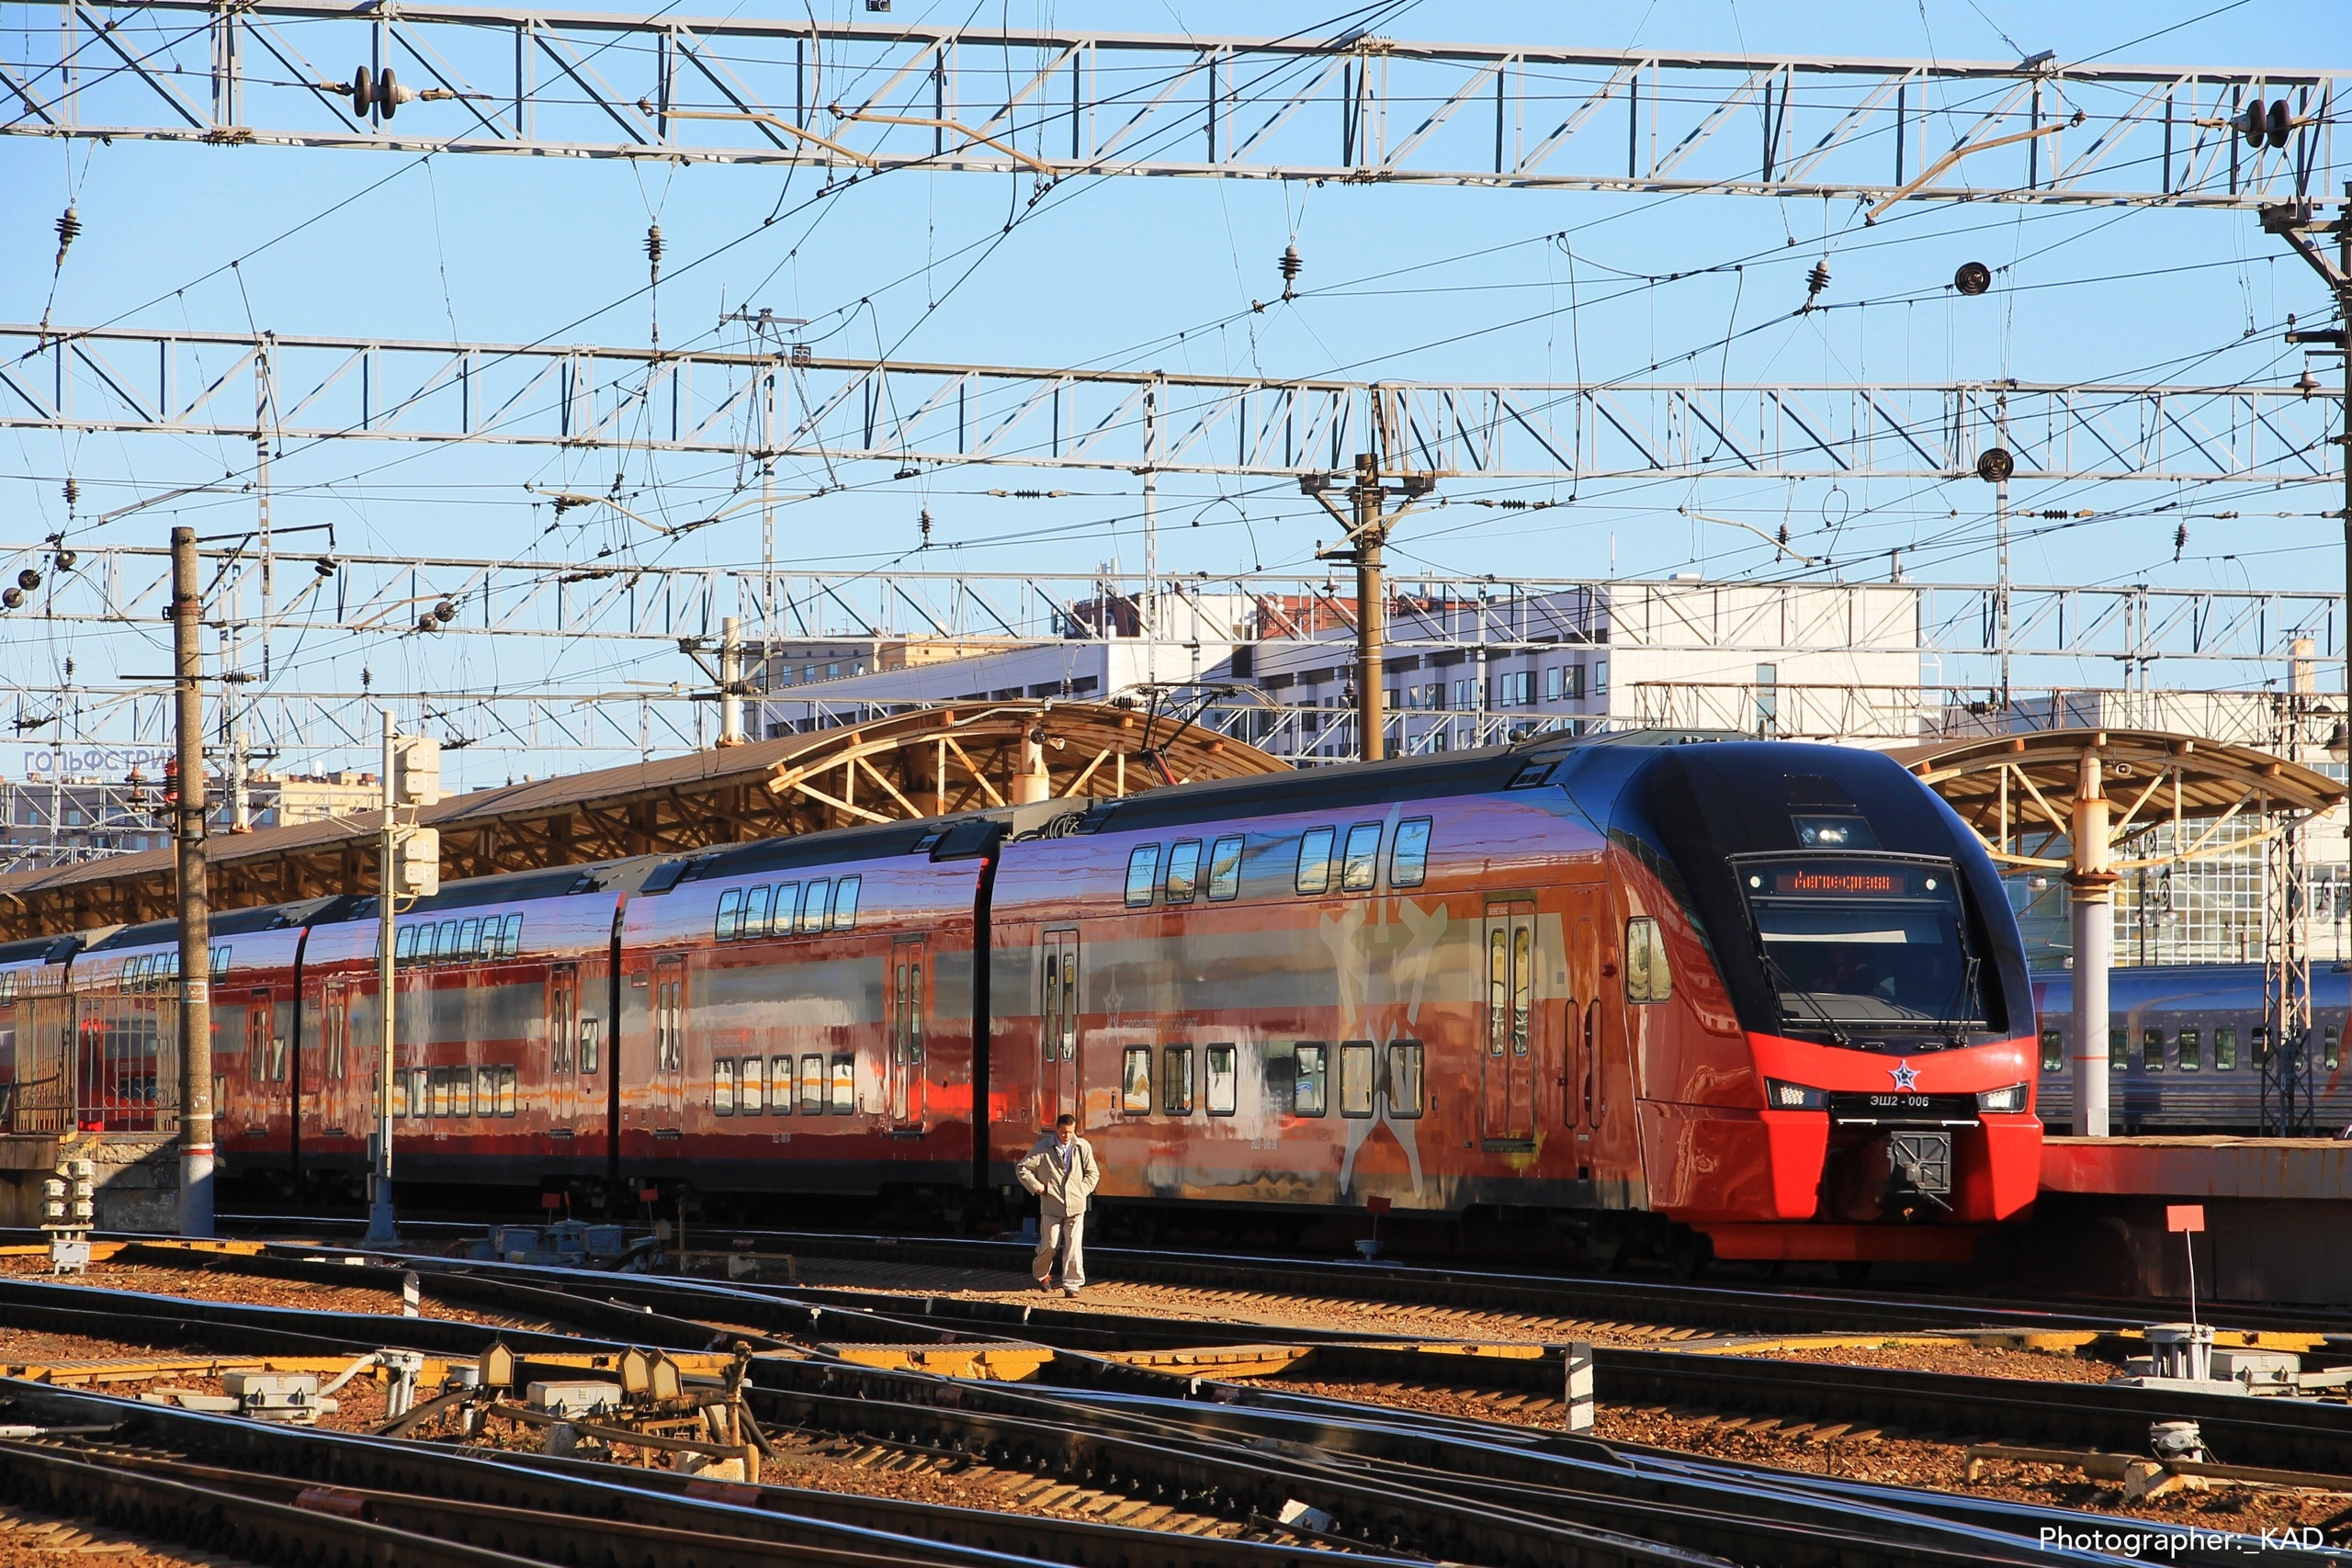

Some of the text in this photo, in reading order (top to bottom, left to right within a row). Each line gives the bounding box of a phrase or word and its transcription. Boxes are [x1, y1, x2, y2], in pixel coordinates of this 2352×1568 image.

[24, 749, 176, 772] ГОЛЬФСТРИ
[1870, 1095, 1898, 1106] ЭШ2
[1908, 1096, 1929, 1107] 006
